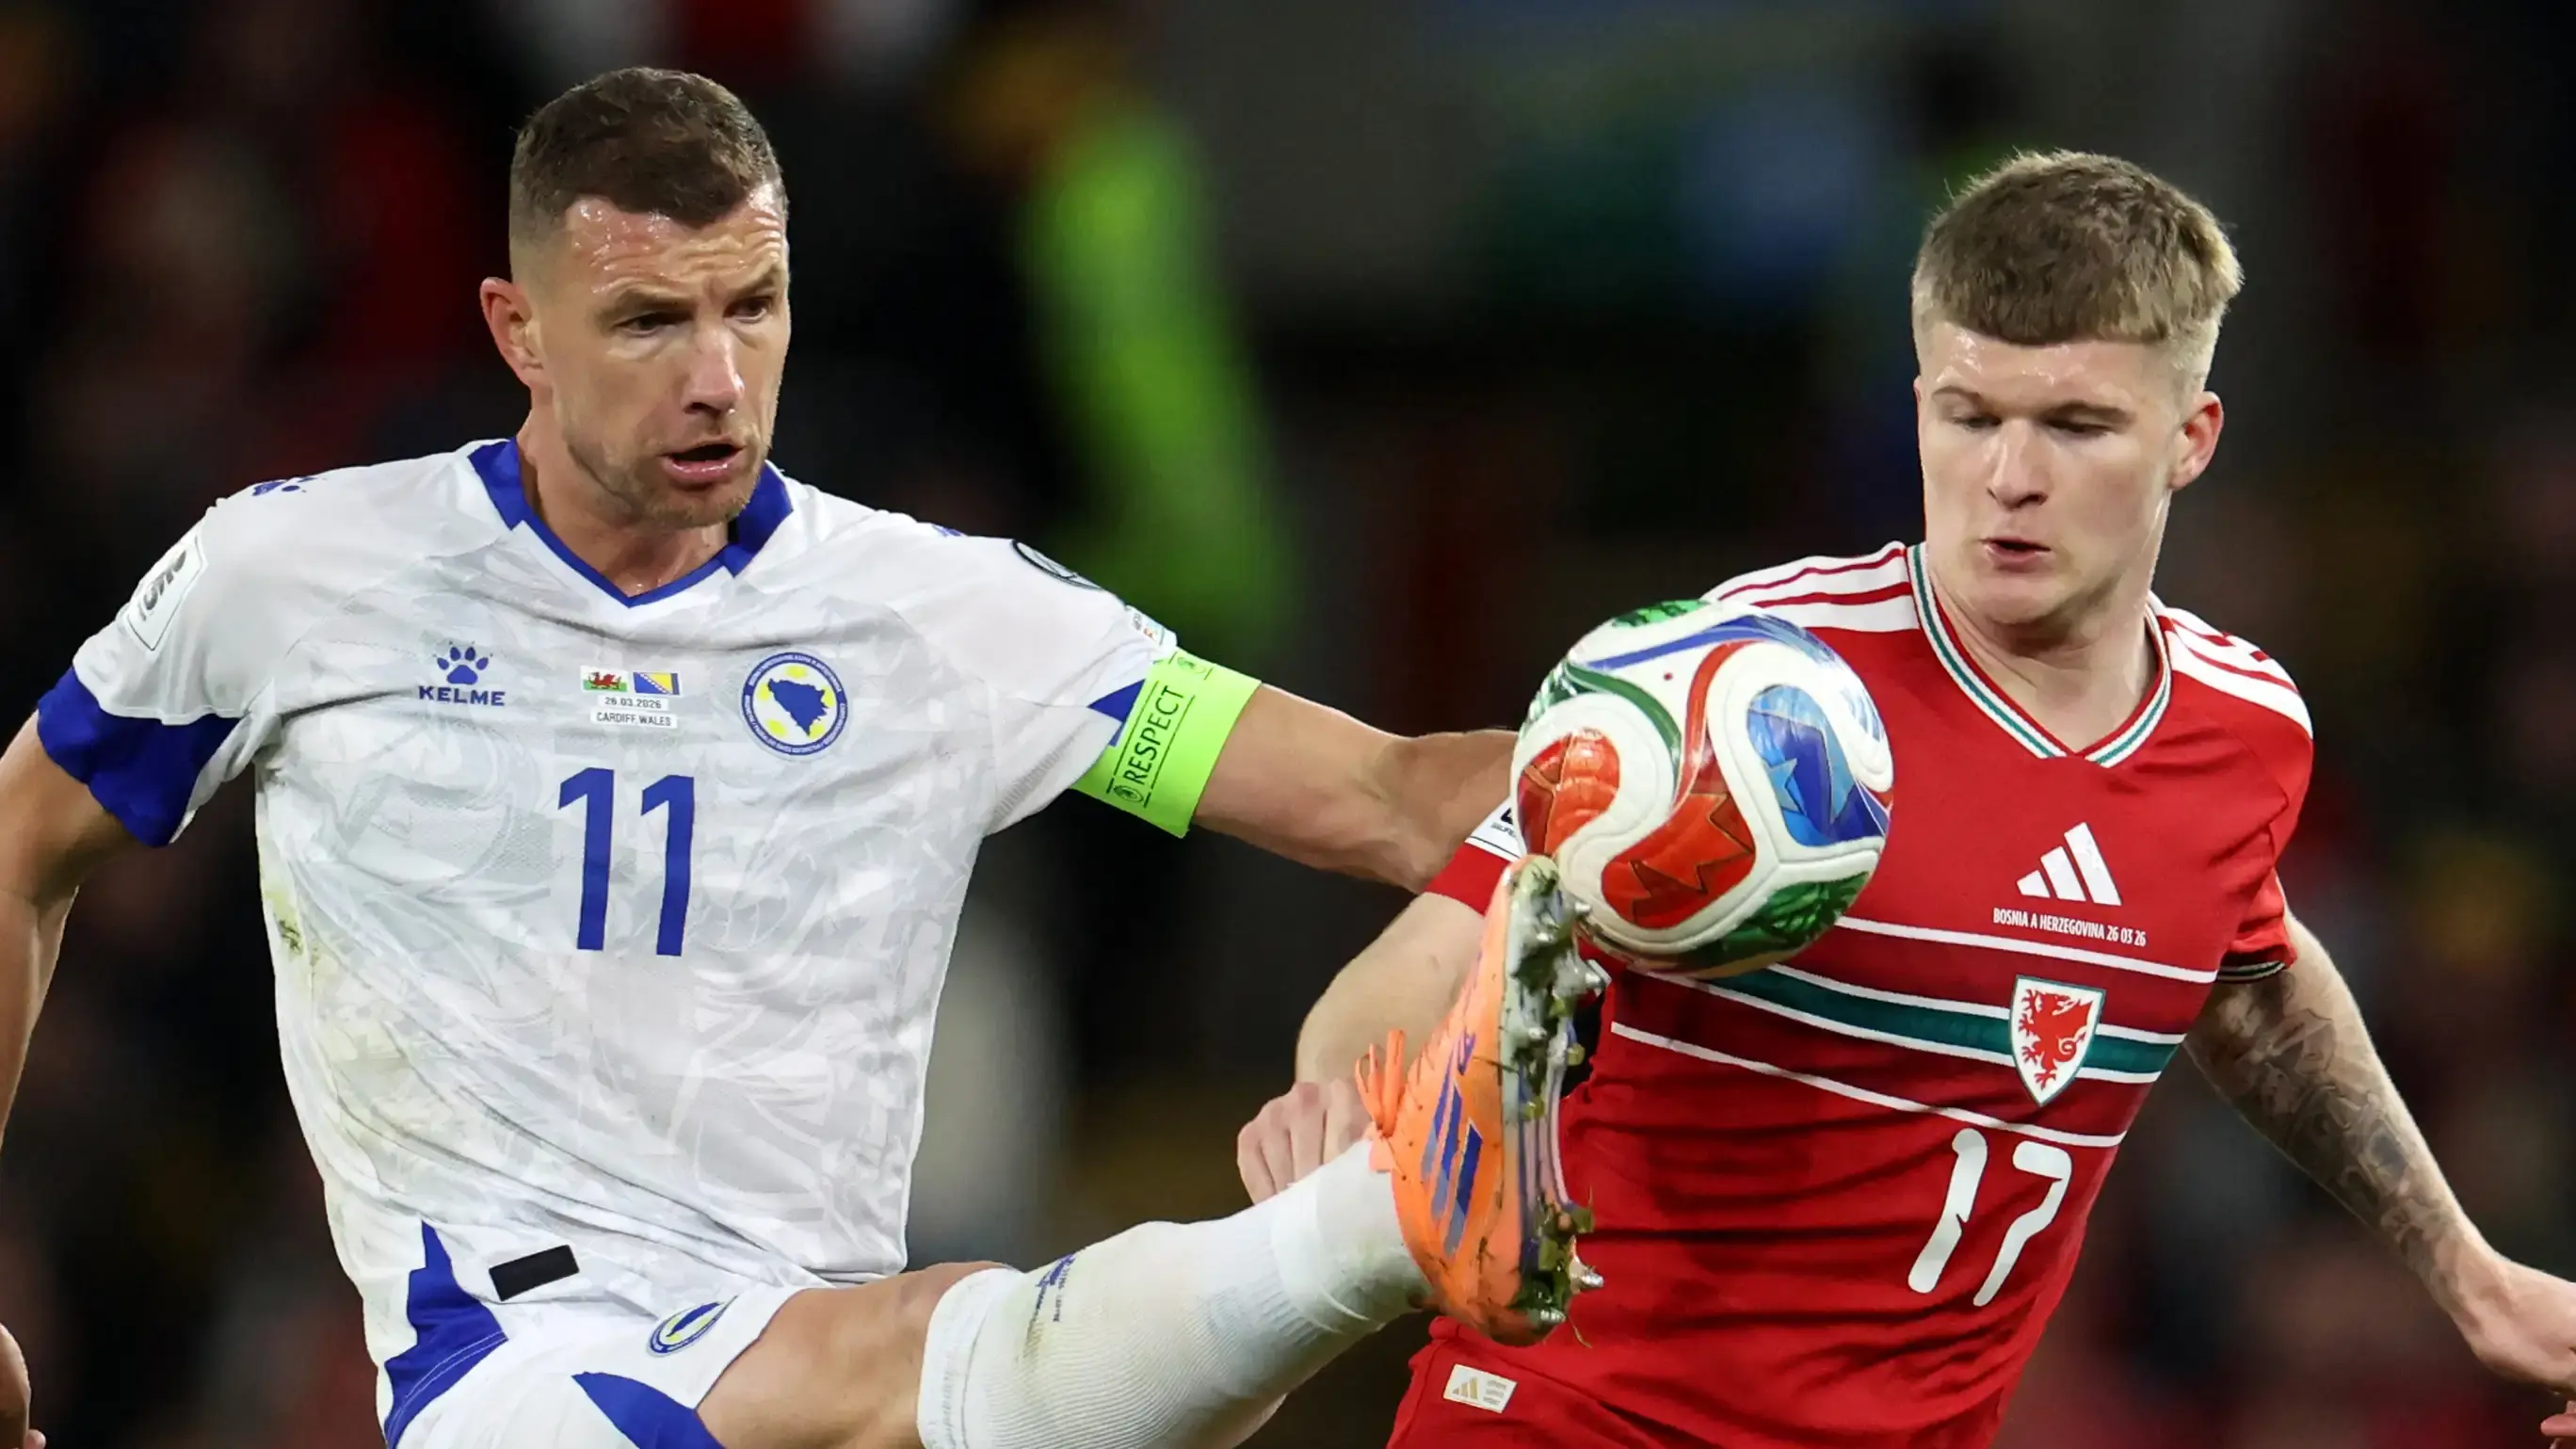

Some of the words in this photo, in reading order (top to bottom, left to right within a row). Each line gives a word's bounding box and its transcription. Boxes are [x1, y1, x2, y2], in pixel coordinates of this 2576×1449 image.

[418, 685, 506, 706] KELME
[639, 715, 671, 727] WALES
[1122, 685, 1183, 785] RESPECT
[558, 767, 694, 957] 11
[1993, 908, 2027, 927] BOSNIA
[2030, 913, 2038, 928] A
[2039, 914, 2104, 940] HERZEGOVINA
[2106, 926, 2118, 942] 26
[2120, 927, 2133, 944] 03
[2134, 930, 2147, 947] 26
[1908, 1128, 2072, 1307] 17
